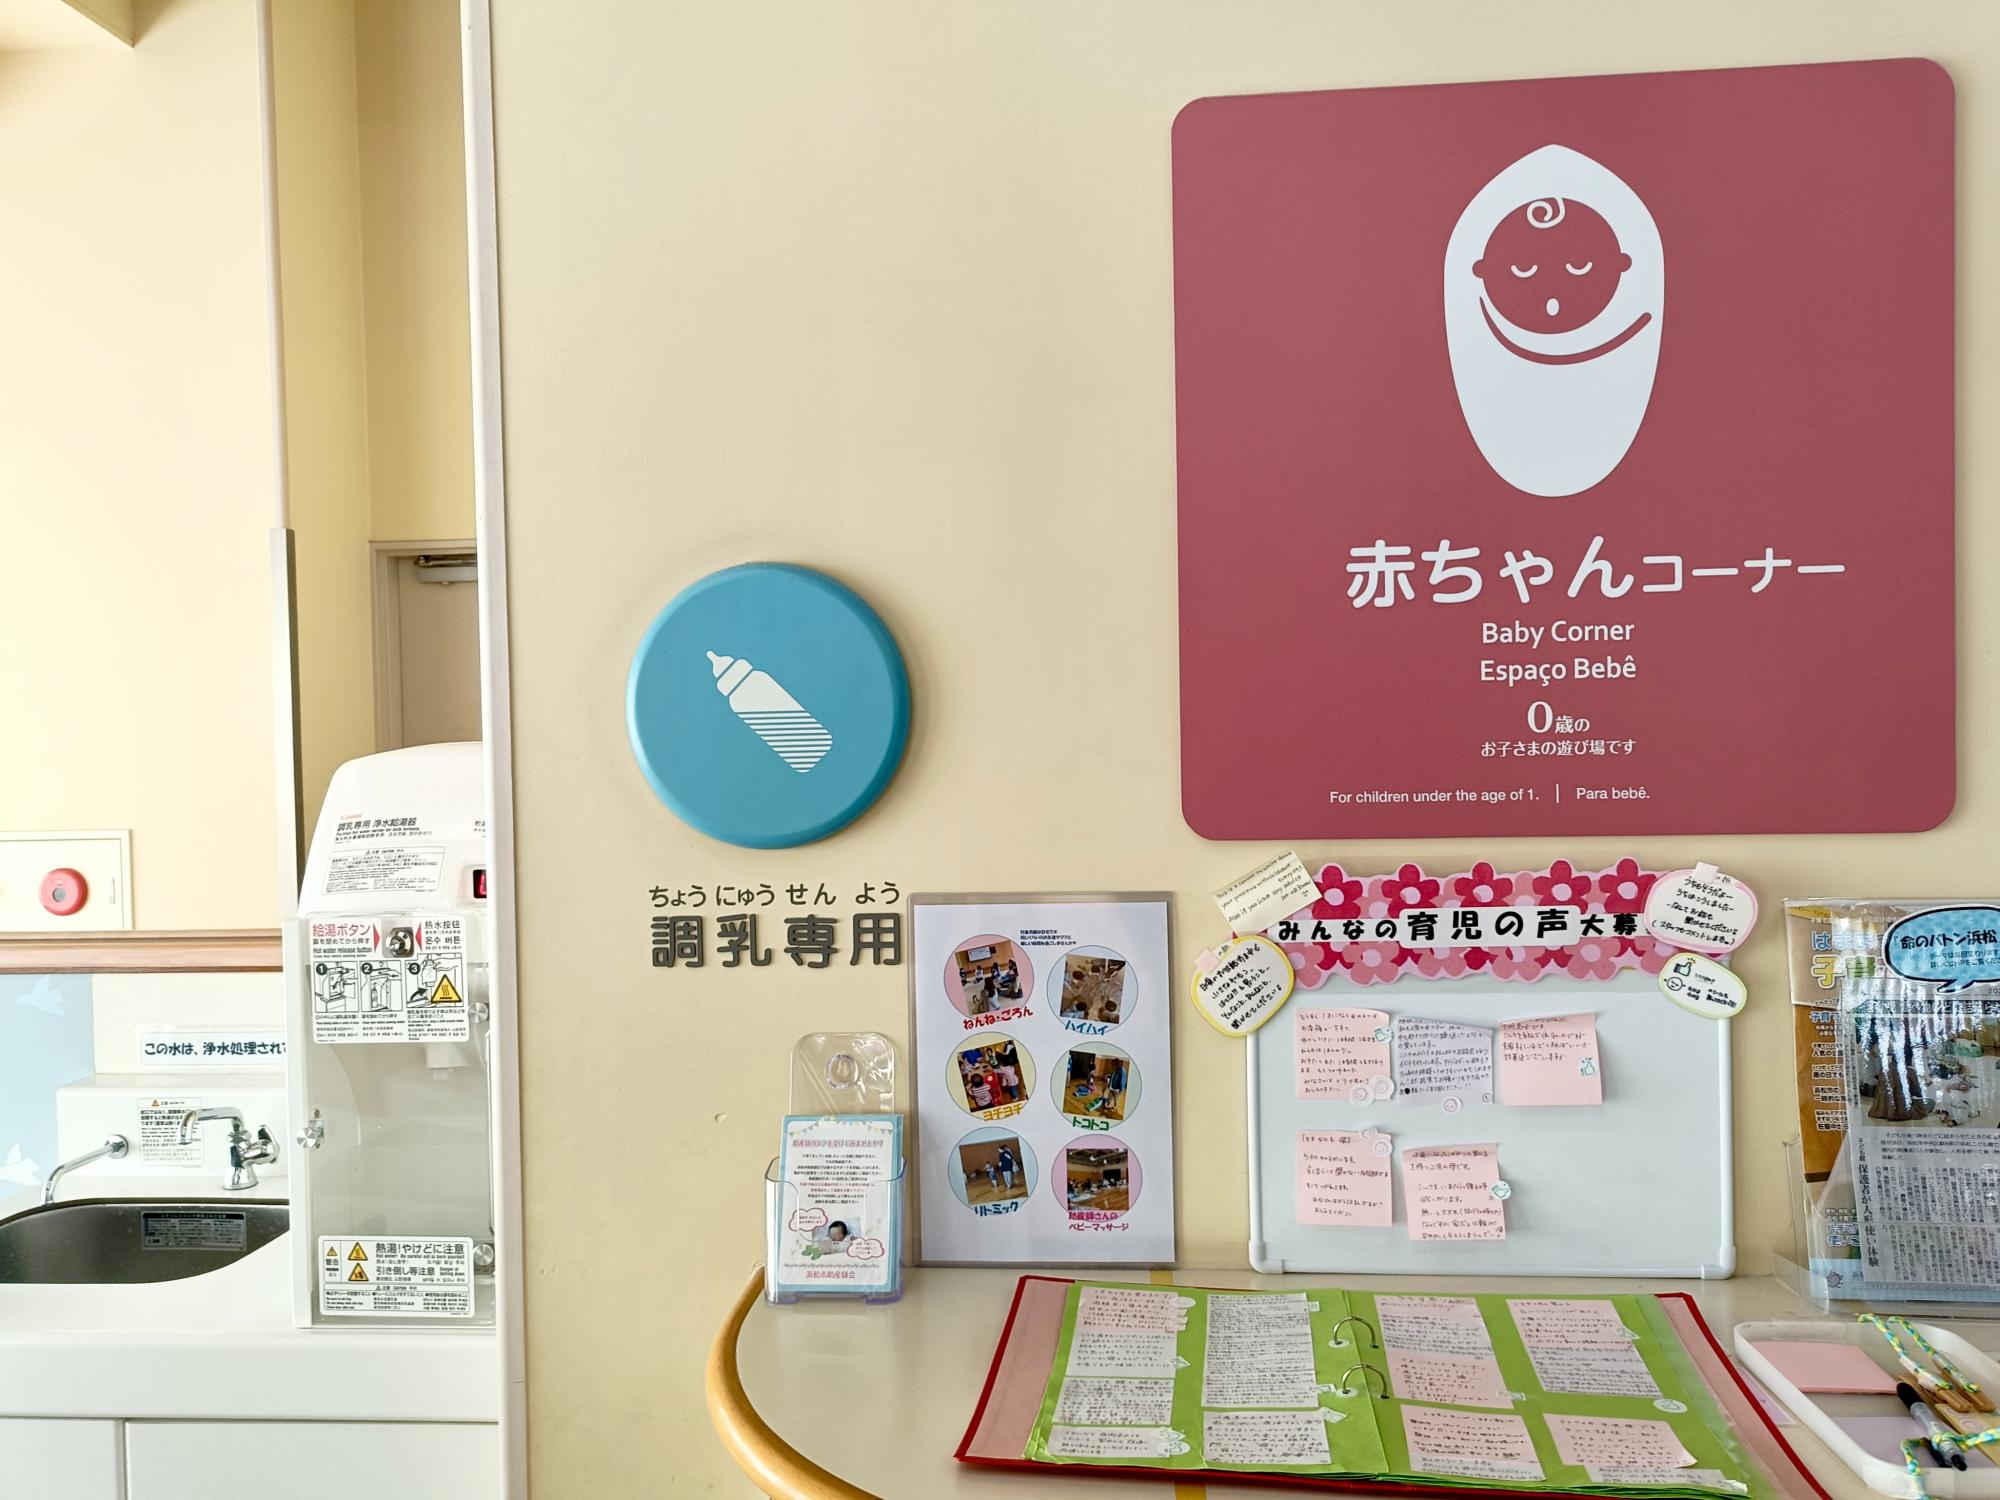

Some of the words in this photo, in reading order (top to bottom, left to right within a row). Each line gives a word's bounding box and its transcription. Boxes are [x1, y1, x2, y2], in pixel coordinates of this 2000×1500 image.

[1345, 535, 1846, 609] 赤ちゃんコーナー
[1482, 620, 1545, 649] Baby
[1551, 619, 1635, 643] Corner
[1480, 659, 1567, 687] Espaço
[1574, 655, 1637, 680] Bebê
[1527, 701, 1591, 734] 0歳の
[1480, 738, 1637, 758] お子さまの遊び場です
[1330, 791, 1353, 804] For
[1355, 790, 1409, 803] children
[1412, 789, 1453, 802] under
[1455, 789, 1478, 802] the
[1481, 791, 1507, 805] age
[1509, 788, 1524, 801] of
[1527, 788, 1540, 801] 1.
[1576, 787, 1609, 800] Para
[1611, 786, 1650, 800] bebê.
[337, 820, 371, 831] 調乳専用
[373, 817, 417, 827] 浄水給湯器
[648, 884, 707, 908] ちょう
[715, 883, 775, 907] にゅう
[785, 882, 837, 906] せん
[855, 881, 900, 905] よう
[312, 923, 370, 937] 給湯ボタン
[1278, 908, 1651, 942] みんなの育児の声大募
[650, 912, 903, 968] 調乳専用
[962, 1006, 1034, 1030] ねんね・ごろん
[1065, 1020, 1108, 1036] ハイハイ
[983, 1104, 1024, 1122] ヨチヨチ
[1072, 1116, 1110, 1132] トコトコ
[974, 1202, 1018, 1216] リトミック
[1068, 1212, 1118, 1221] 助産師さんの
[1068, 1223, 1129, 1232] ベビーマッサージ
[376, 1266, 435, 1276] 引き倒し等注意
